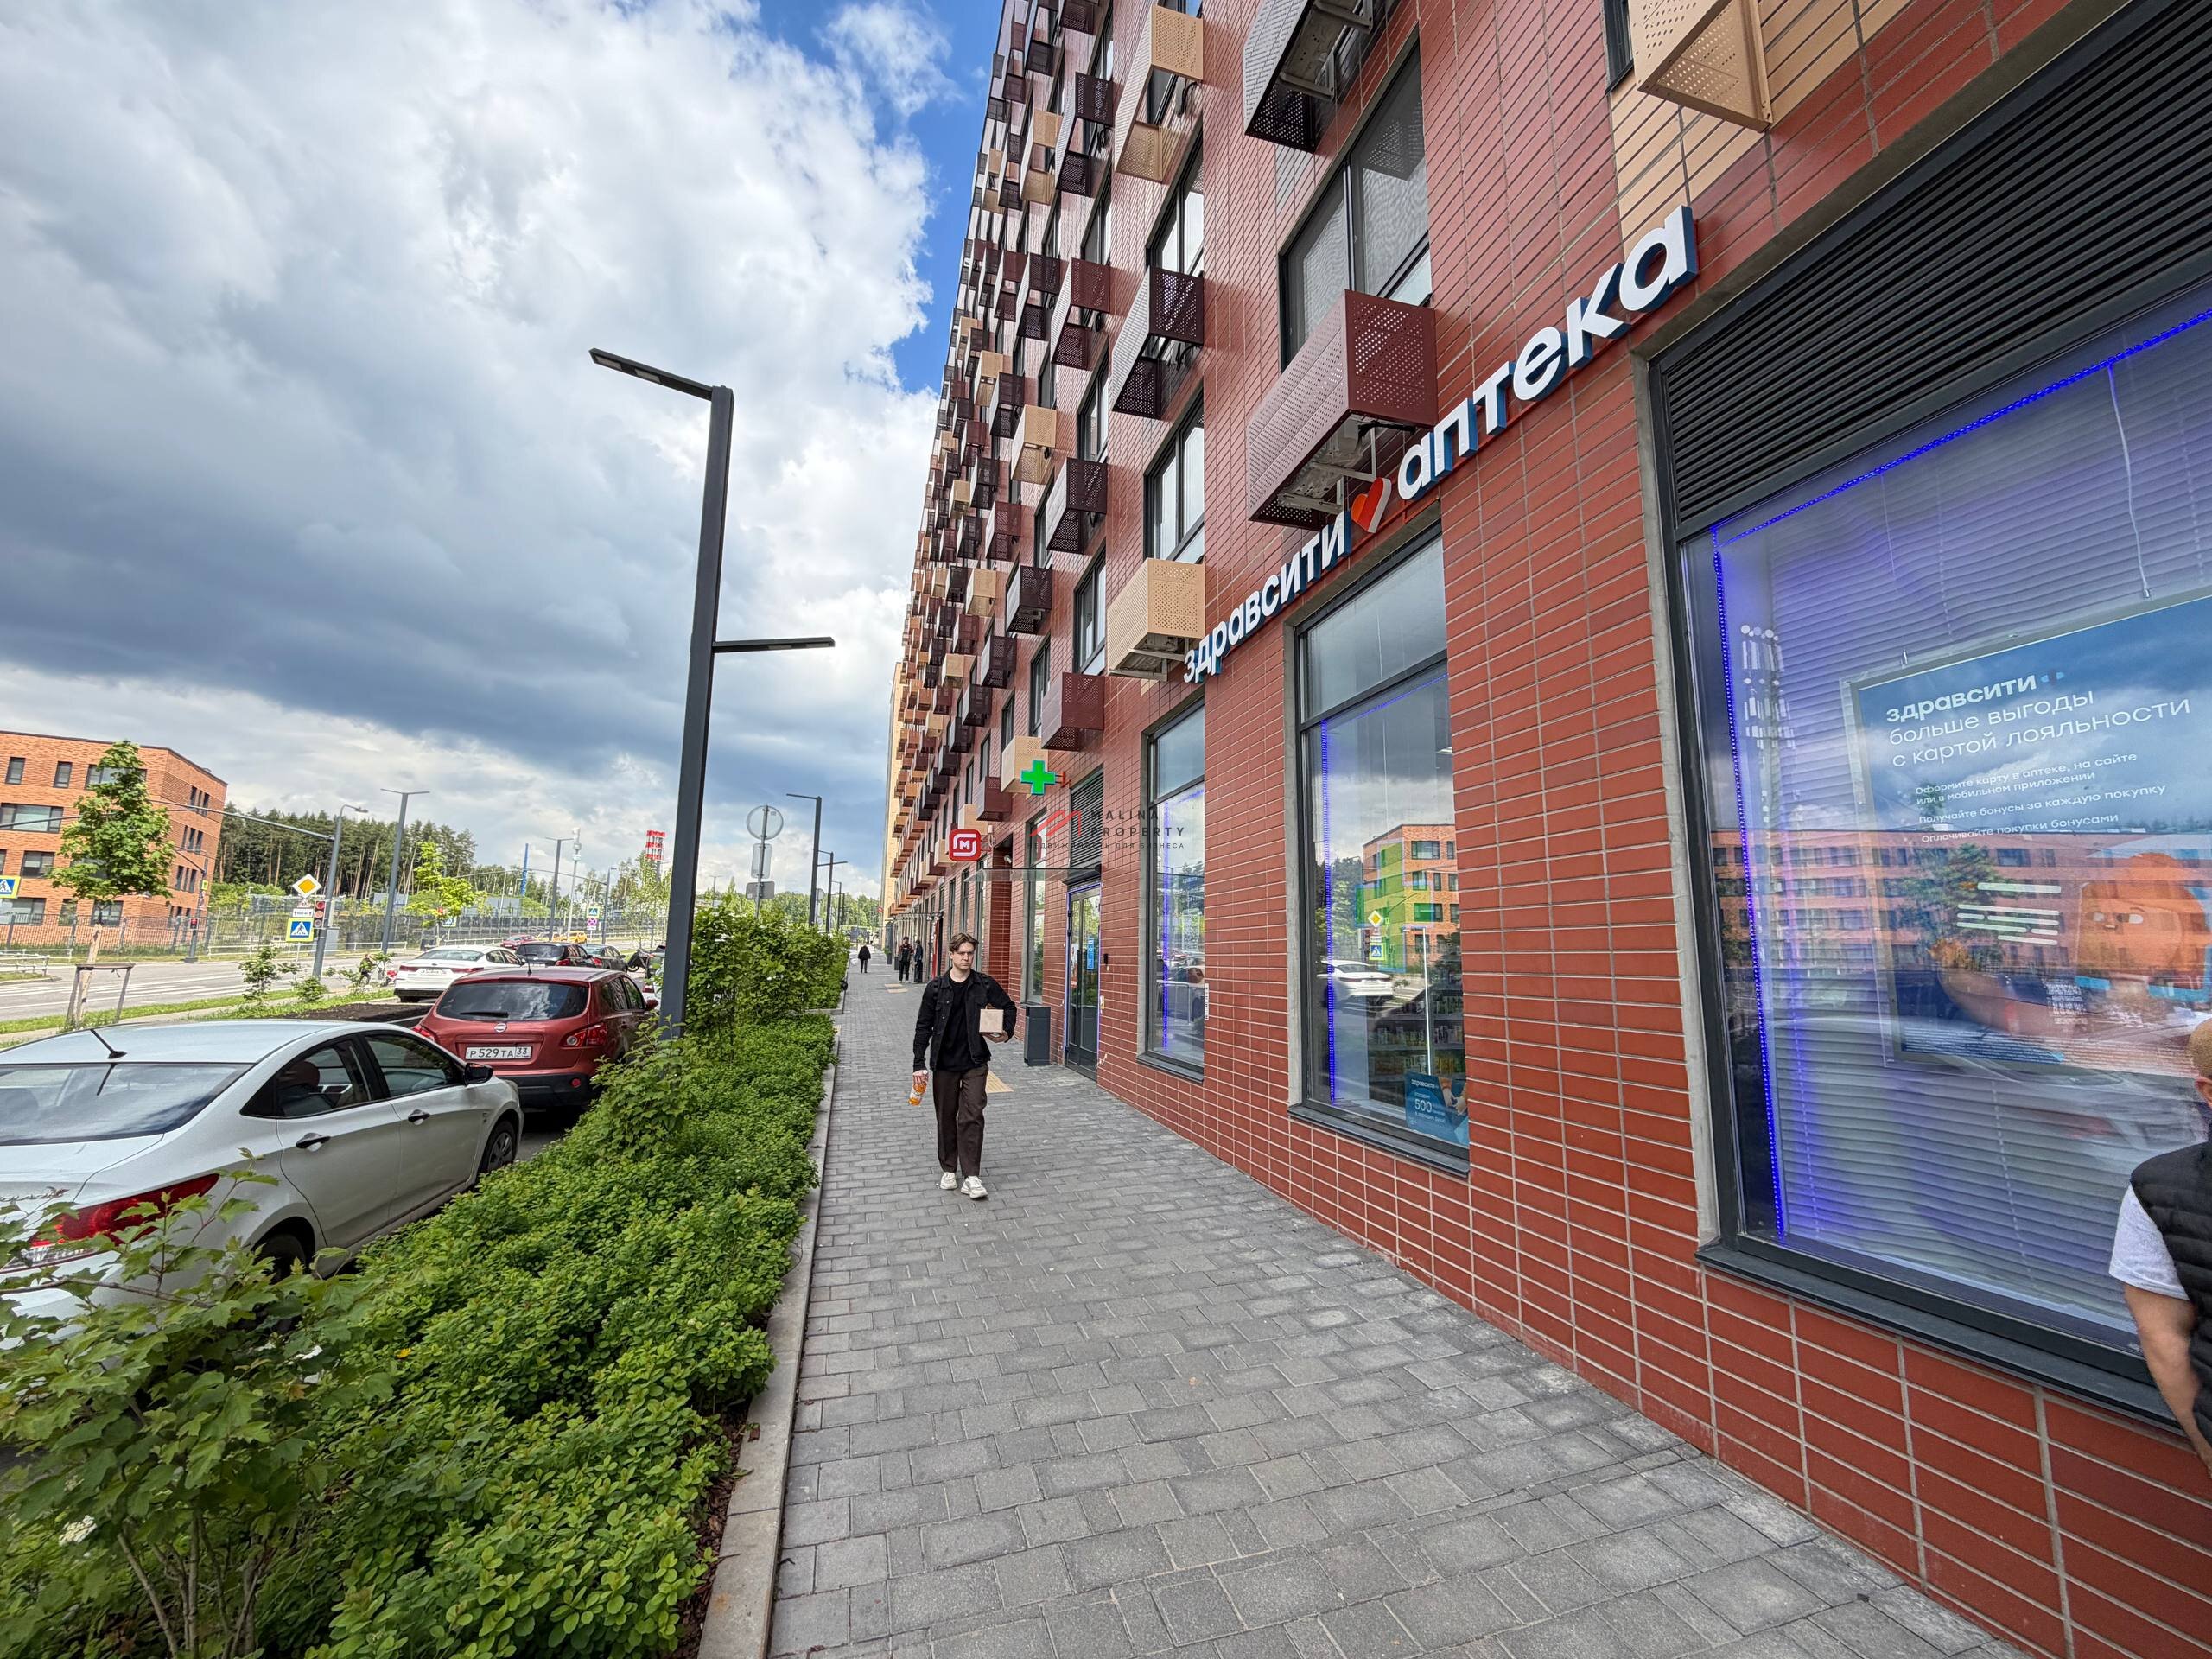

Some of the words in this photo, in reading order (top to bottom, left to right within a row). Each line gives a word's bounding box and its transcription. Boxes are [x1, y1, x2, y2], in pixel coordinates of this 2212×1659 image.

[1183, 510, 1350, 683] здравсити
[1398, 205, 1696, 500] аптека
[1886, 675, 2037, 723] здравсити
[1890, 716, 1980, 745] больше
[1988, 691, 2094, 725] выгоды
[1892, 754, 1906, 766] с
[1913, 732, 1997, 764] картой
[2006, 699, 2190, 747] лояльности
[1915, 779, 1973, 795] Оформите
[1976, 774, 2009, 785] карту
[2023, 764, 2070, 778] аптеке,
[2074, 760, 2091, 770] на
[2094, 753, 2138, 766] сайте
[1916, 796, 1936, 804] или
[1948, 785, 2011, 801] мобильном
[2013, 772, 2095, 791] приложении
[1919, 809, 1977, 823] Получайте
[1980, 804, 2024, 816] бонусы
[2027, 801, 2042, 810] за
[2045, 794, 2101, 808] каждую
[2105, 785, 2166, 800] покупку
[1922, 827, 1993, 843] Оплачивайте
[1997, 821, 2048, 836] покупки
[2050, 814, 2119, 829] бонусами
[1414, 1098, 1432, 1113] 500
